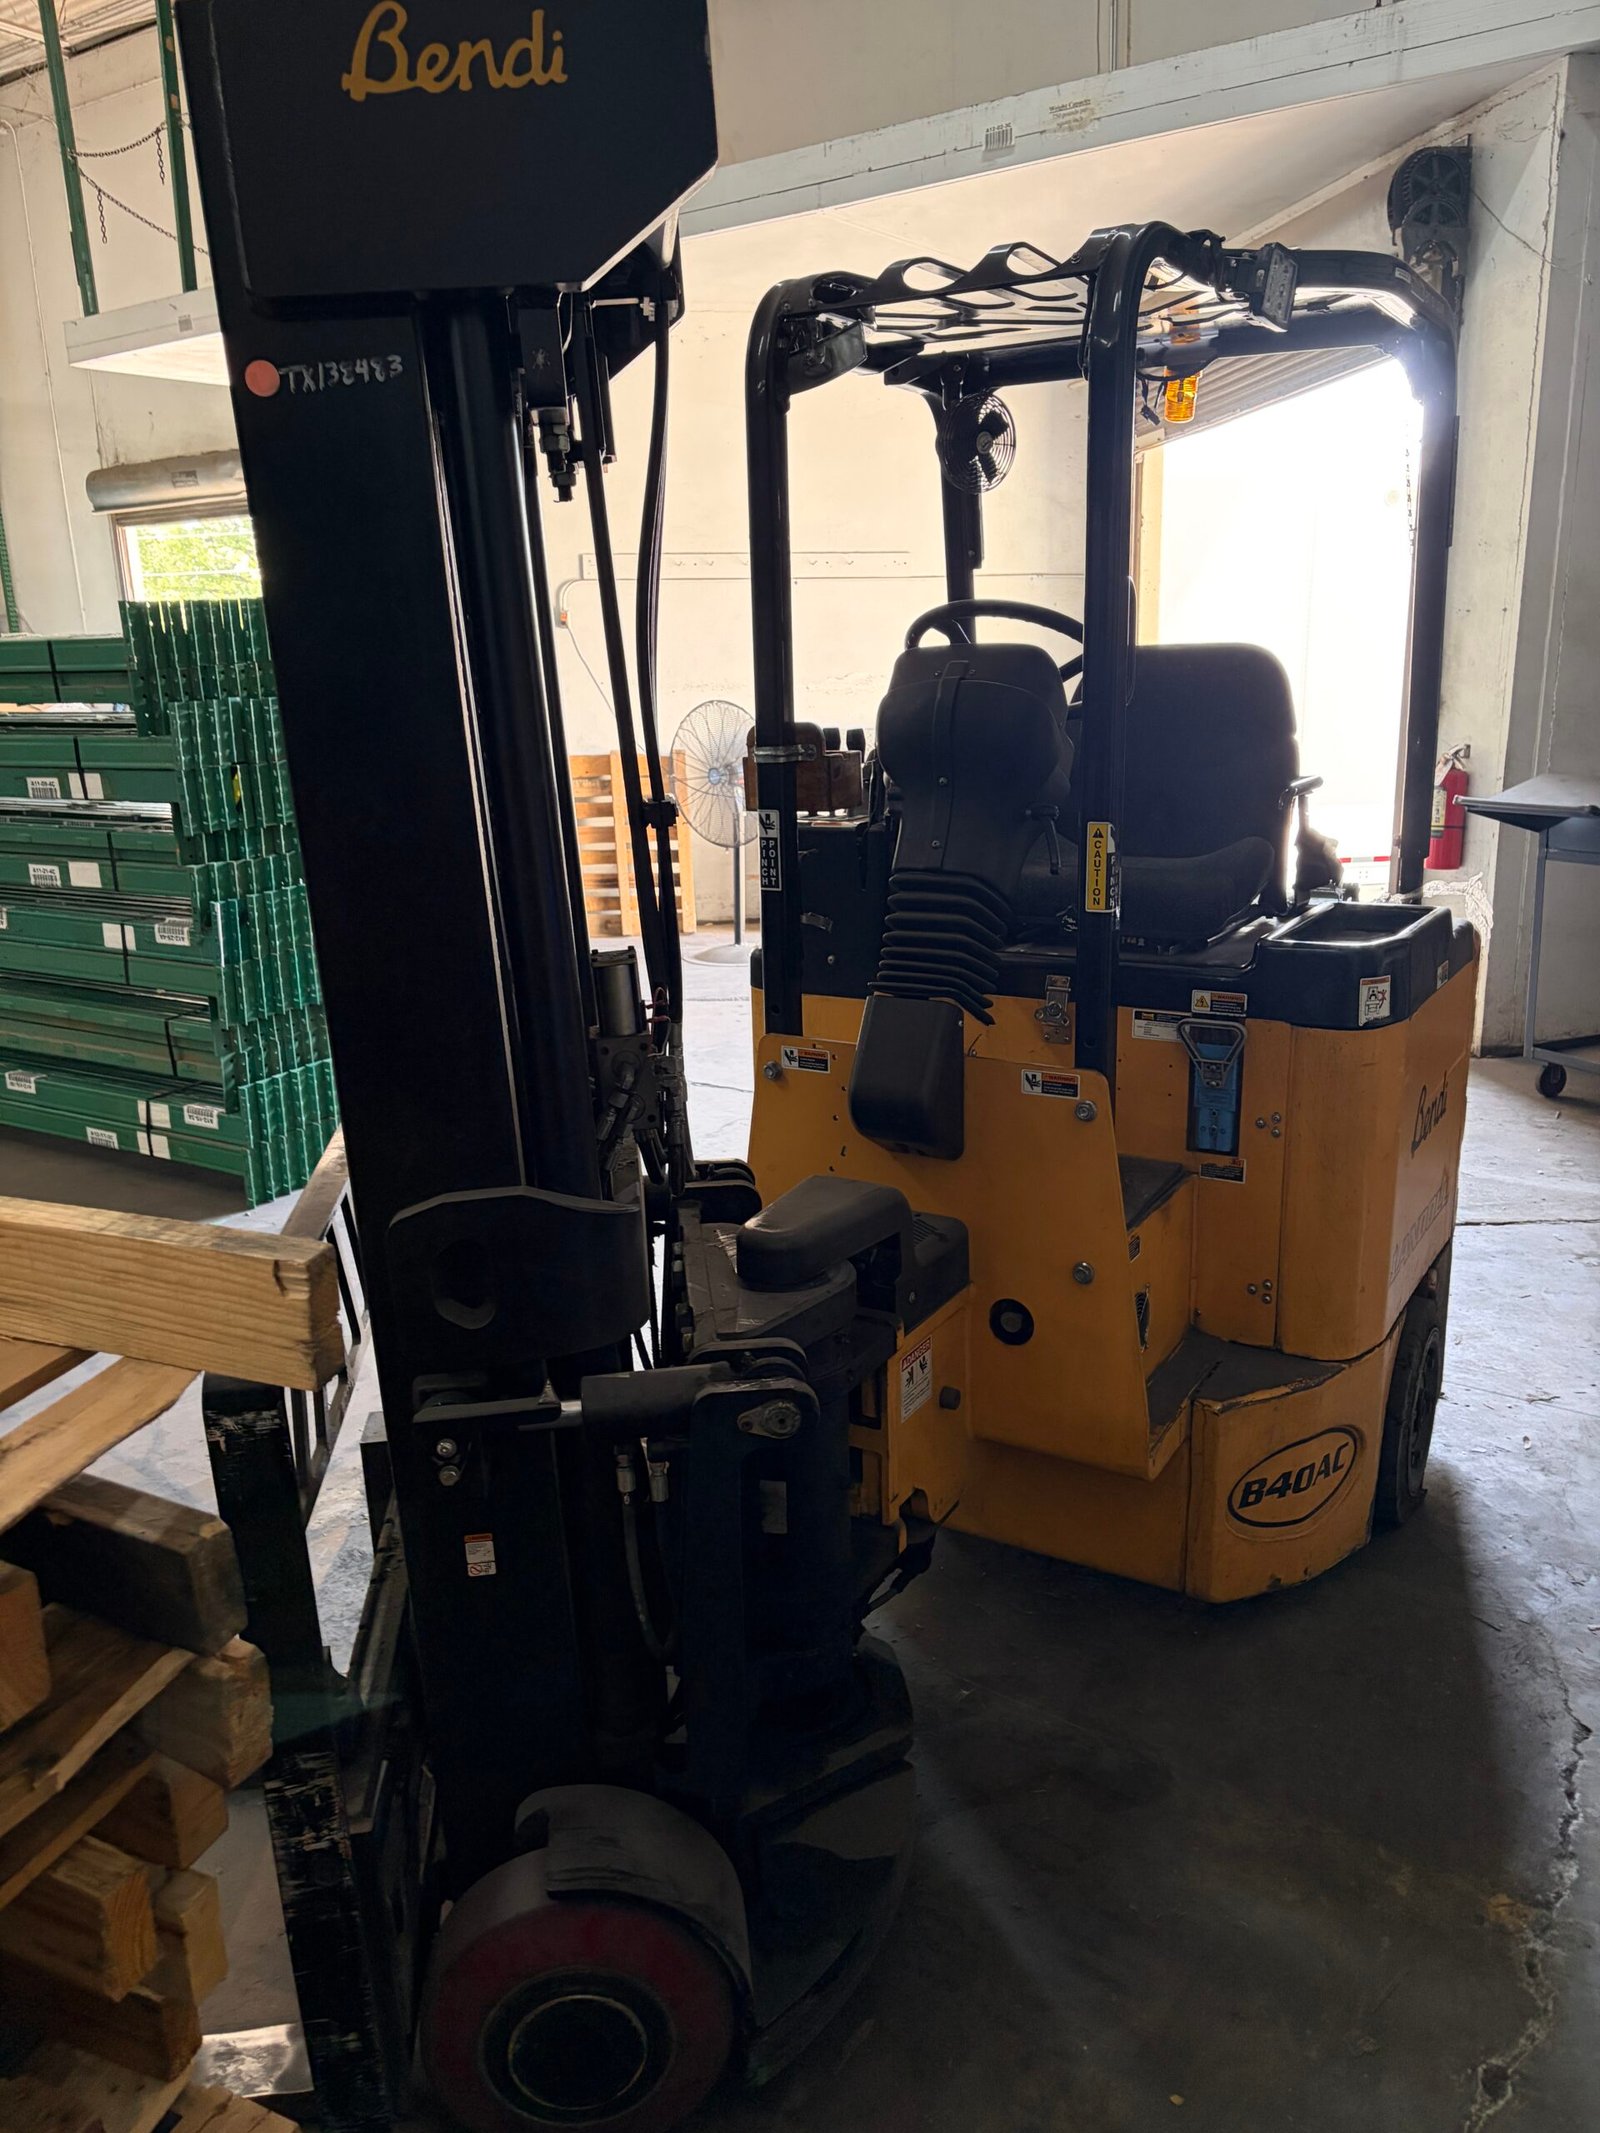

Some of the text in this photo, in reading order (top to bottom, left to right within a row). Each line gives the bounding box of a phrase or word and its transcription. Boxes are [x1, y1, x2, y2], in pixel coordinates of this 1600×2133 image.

[340, 0, 568, 102] Bendi
[761, 840, 769, 886] PINCH
[769, 840, 777, 886] POINT
[1092, 840, 1102, 906] CAUTION
[1411, 1069, 1448, 1159] Bendi
[1238, 1441, 1349, 1509] B40AC
